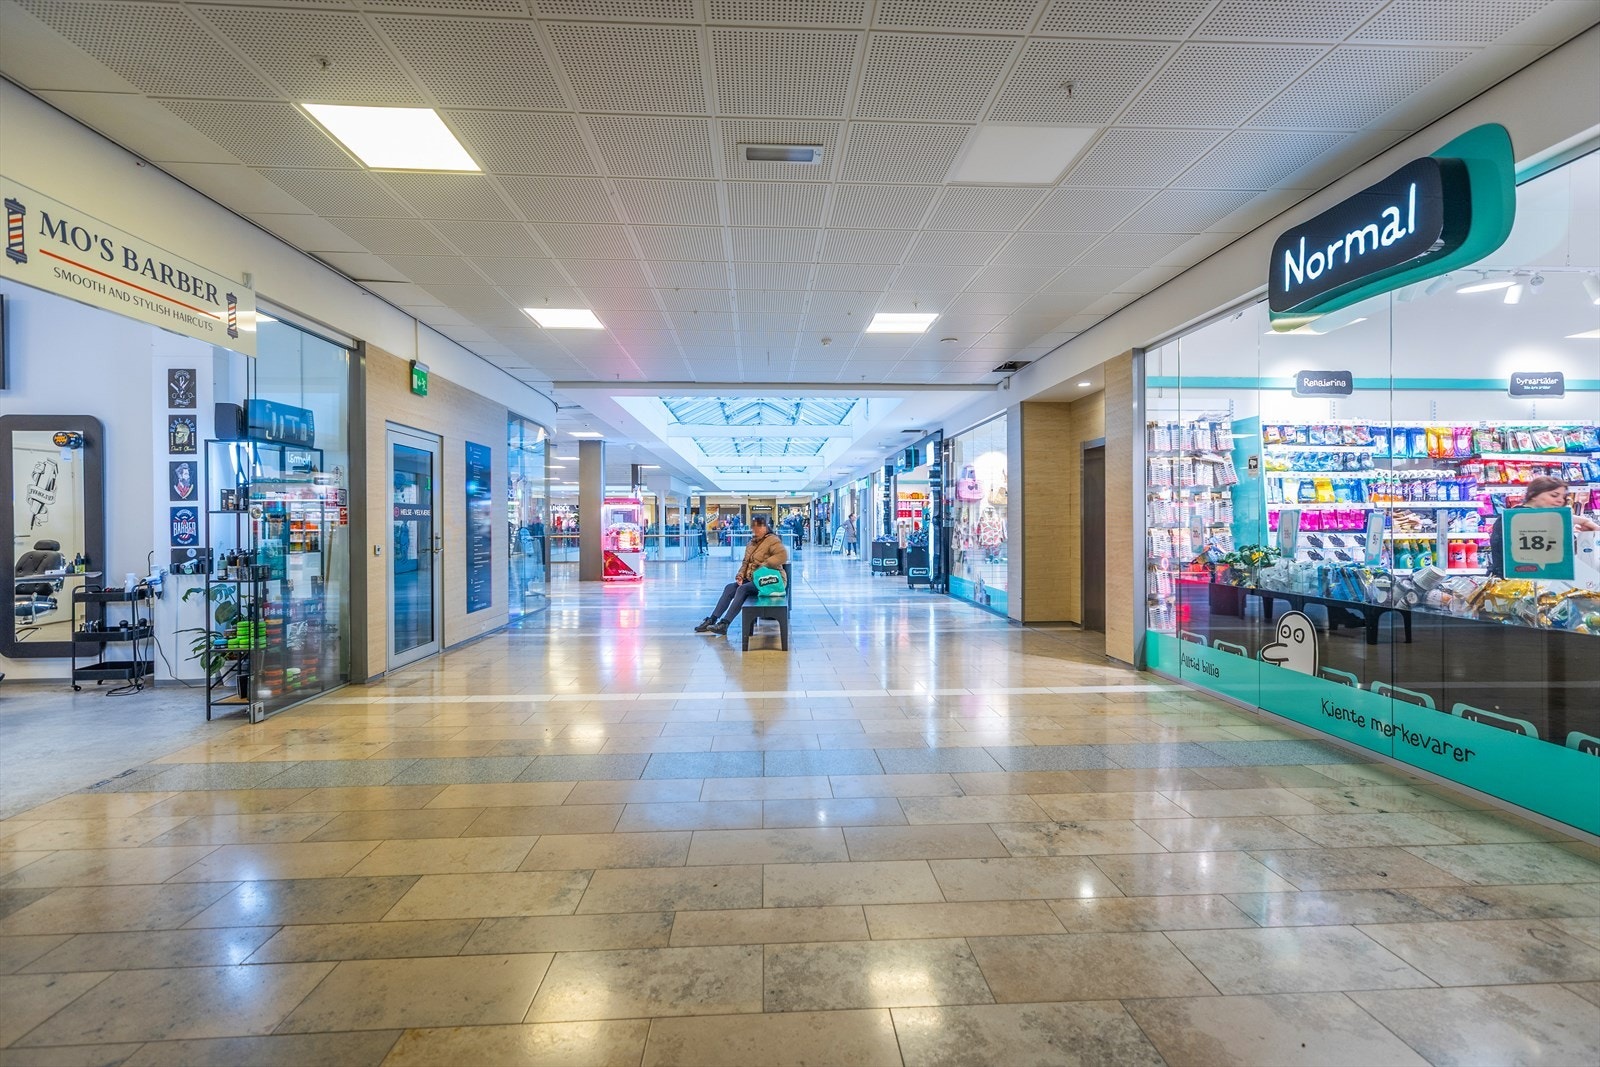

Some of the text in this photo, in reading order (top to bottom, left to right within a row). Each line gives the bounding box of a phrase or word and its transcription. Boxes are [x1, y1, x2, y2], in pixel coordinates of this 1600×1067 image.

[39, 210, 220, 306] MO'S BARBER
[1285, 182, 1416, 292] Normal
[53, 266, 214, 332] SMOOTH AND STYLISH HAIRCUTS
[173, 521, 197, 537] BARBER
[1519, 535, 1557, 552] 18,-
[1181, 652, 1220, 678] Alltid billig
[1321, 697, 1366, 728] Kjente
[1371, 716, 1476, 763] merkevarer
